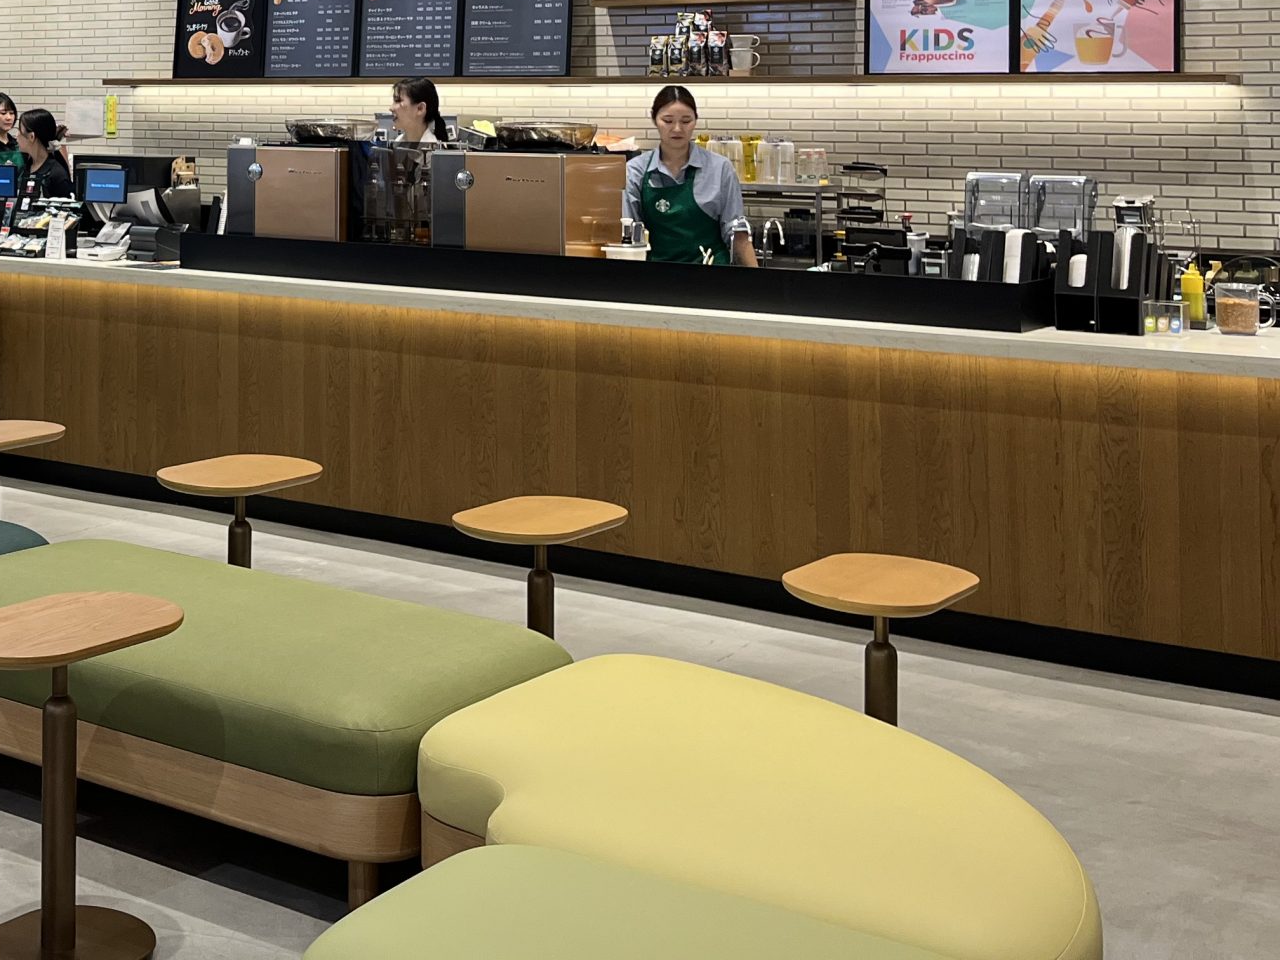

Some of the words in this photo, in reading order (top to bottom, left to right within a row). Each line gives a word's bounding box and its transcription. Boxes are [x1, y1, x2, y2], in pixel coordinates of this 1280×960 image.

[189, 3, 222, 16] Morning
[900, 28, 974, 51] KIDS
[900, 51, 975, 63] Frappuccino
